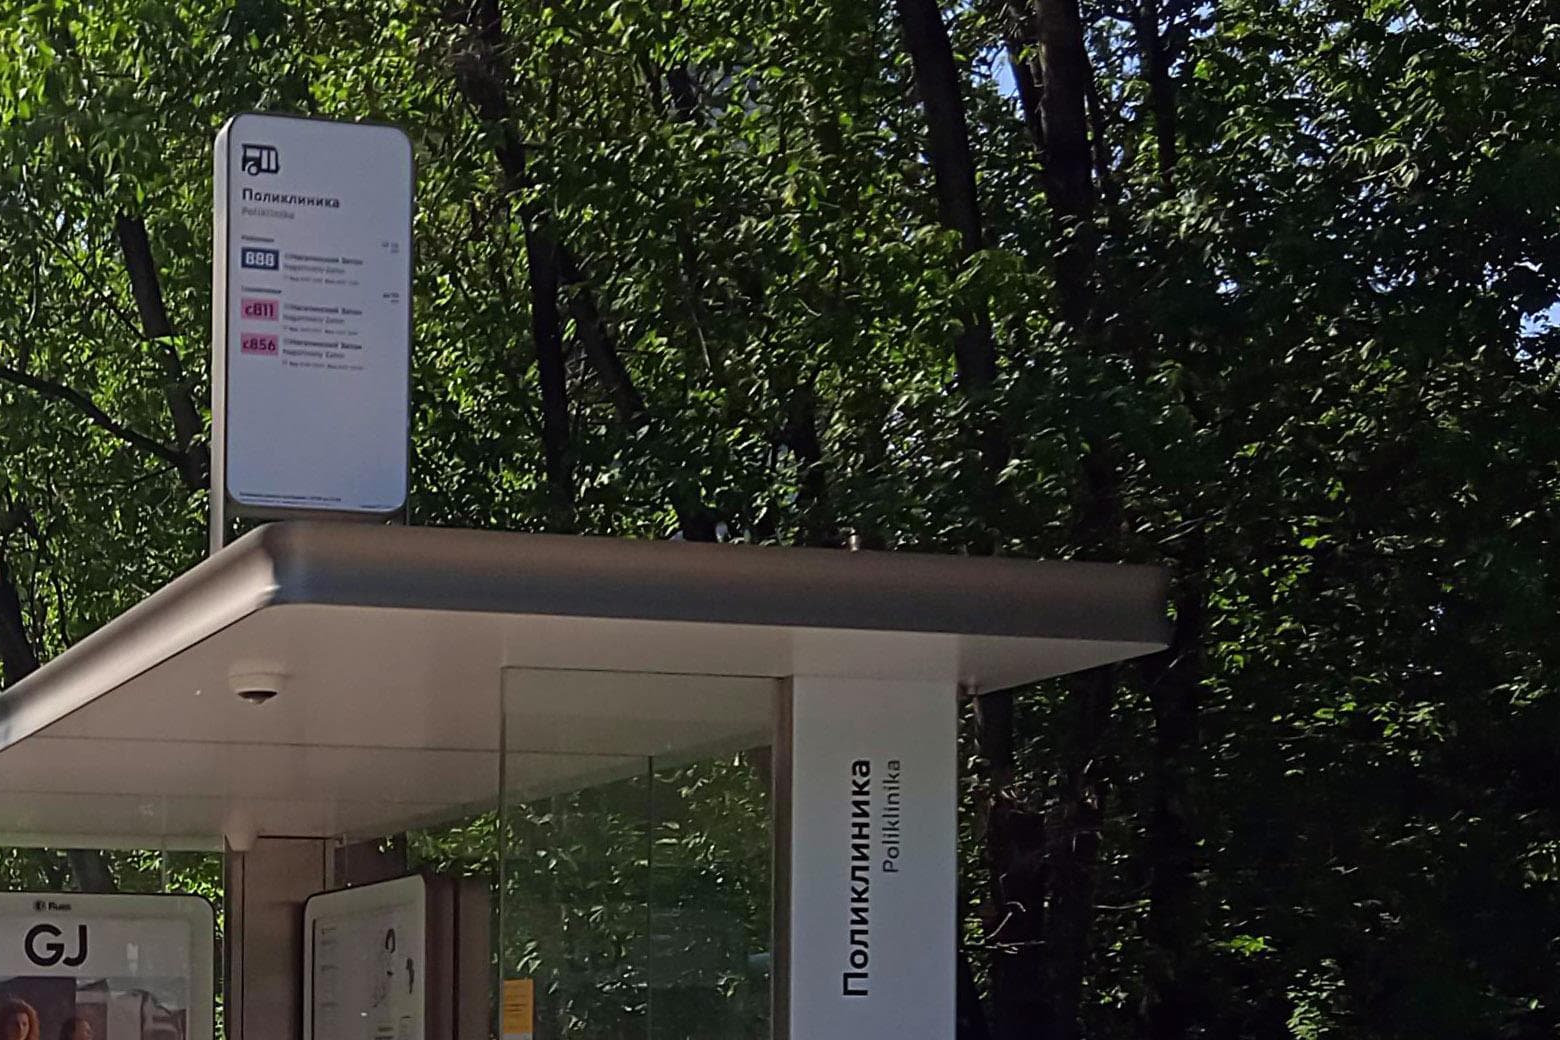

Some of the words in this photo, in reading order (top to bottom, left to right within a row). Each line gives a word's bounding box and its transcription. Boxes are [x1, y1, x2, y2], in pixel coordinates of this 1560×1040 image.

[242, 188, 339, 208] Поликлиника
[882, 760, 900, 873] Poliklinika
[842, 759, 871, 996] Поликлиника
[24, 923, 88, 967] GJ
